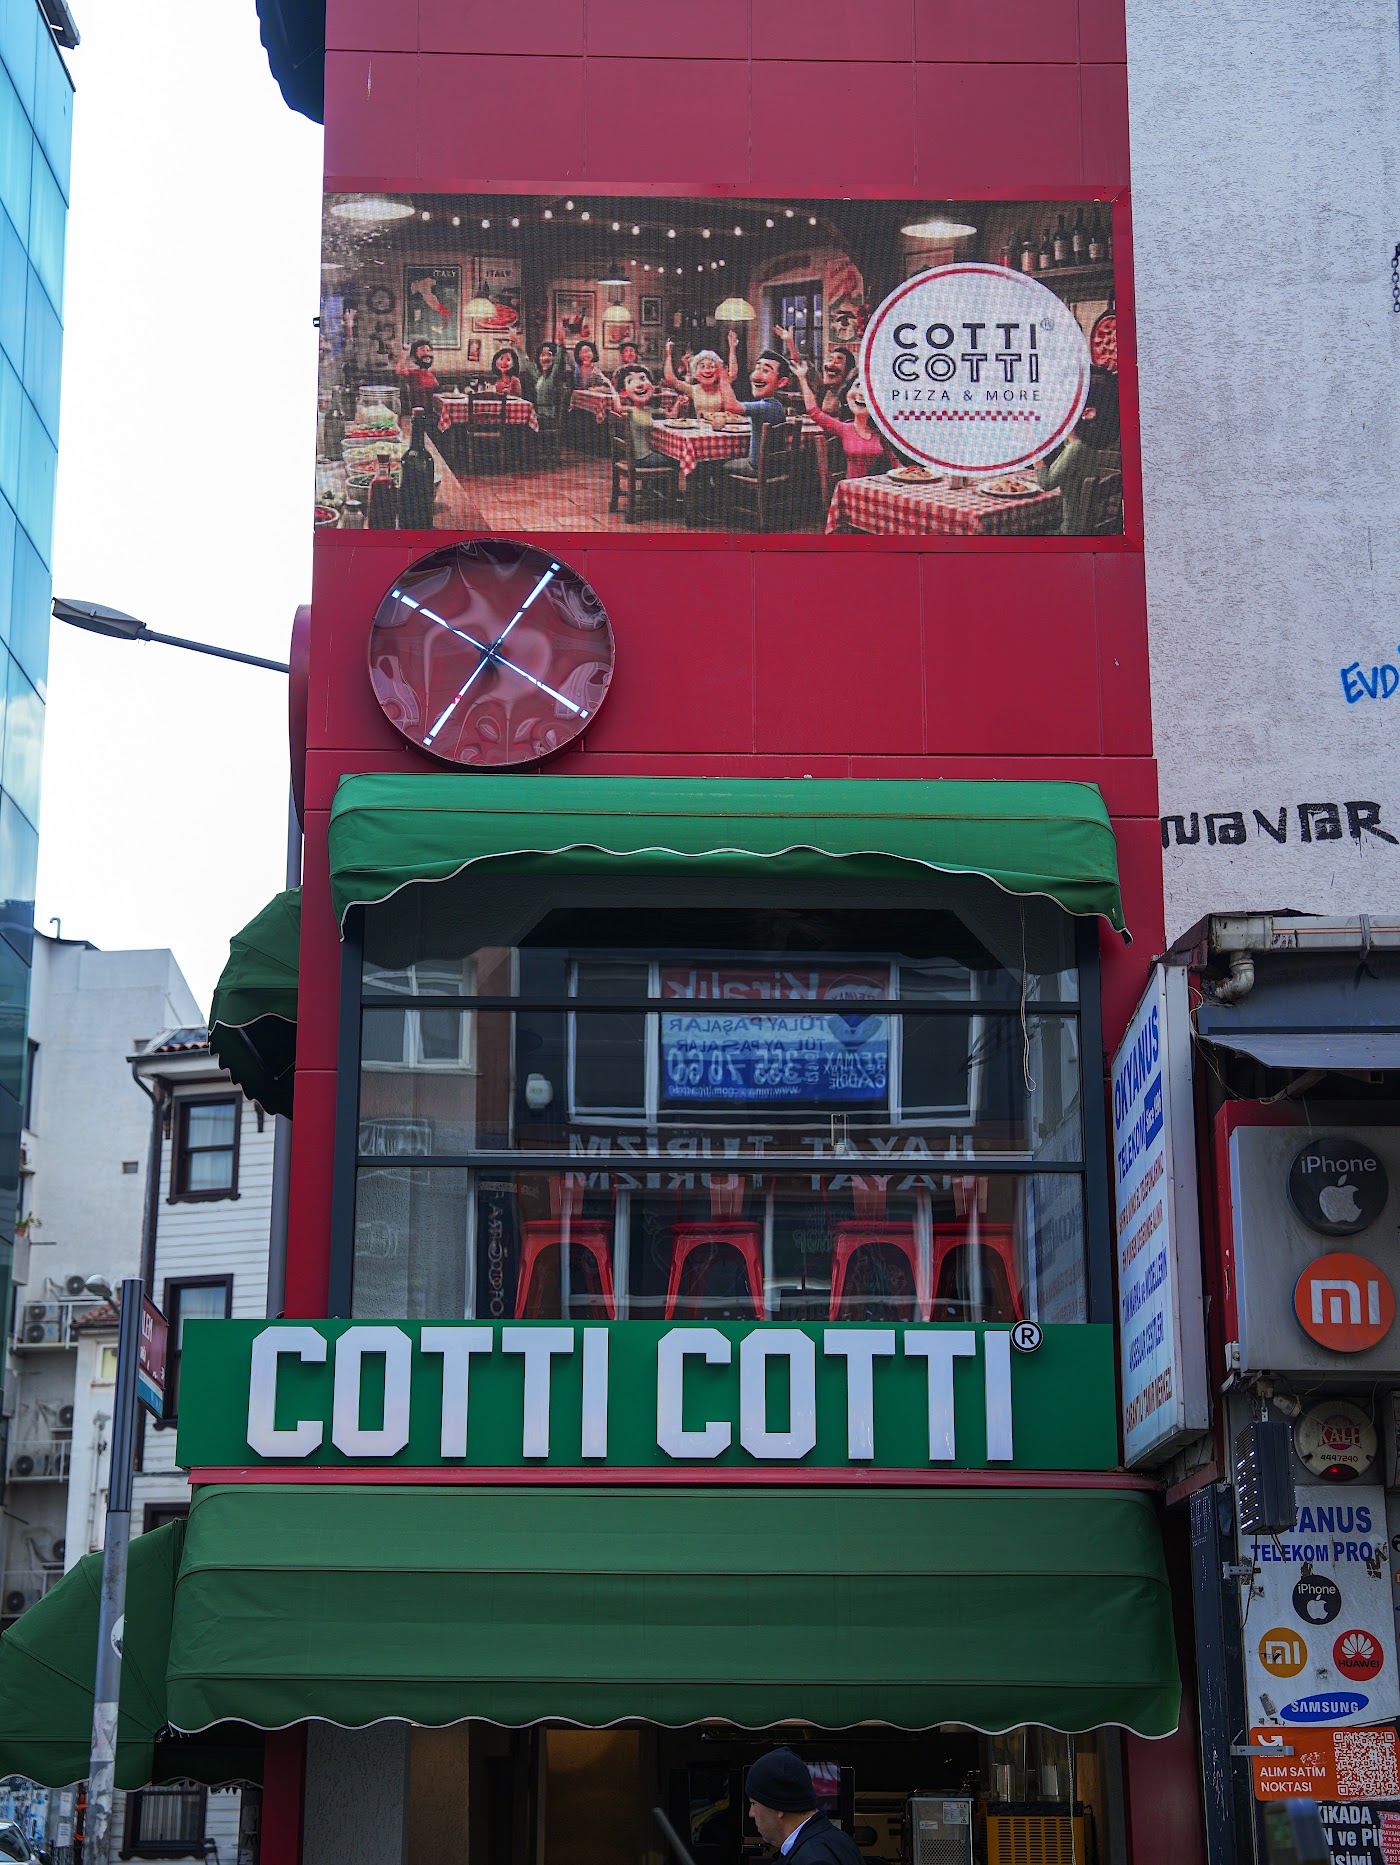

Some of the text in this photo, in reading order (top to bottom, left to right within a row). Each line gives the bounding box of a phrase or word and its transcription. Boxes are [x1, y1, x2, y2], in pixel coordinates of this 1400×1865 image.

[893, 322, 1037, 350] COTTI
[892, 352, 1040, 384] COTTI
[891, 389, 1041, 402] PIZZA & MORE
[1340, 661, 1400, 705] EVD
[1114, 1004, 1160, 1131] OKYANUS
[1117, 1111, 1147, 1184] TELEKOM
[1300, 1155, 1377, 1174] iPhone
[246, 1326, 609, 1458] COTTI
[656, 1327, 1013, 1462] COTTI
[1320, 1454, 1359, 1463] 4447240
[1289, 1506, 1372, 1533] ANUS
[1250, 1541, 1373, 1562] TELEKOM PRO
[1297, 1584, 1337, 1595] iPhone
[1338, 1659, 1380, 1668] HUAWEI
[1291, 1700, 1359, 1713] SAMSUNG
[1260, 1766, 1288, 1777] ALIM
[1261, 1781, 1313, 1792] NOKTASI
[1337, 1830, 1357, 1847] ve
